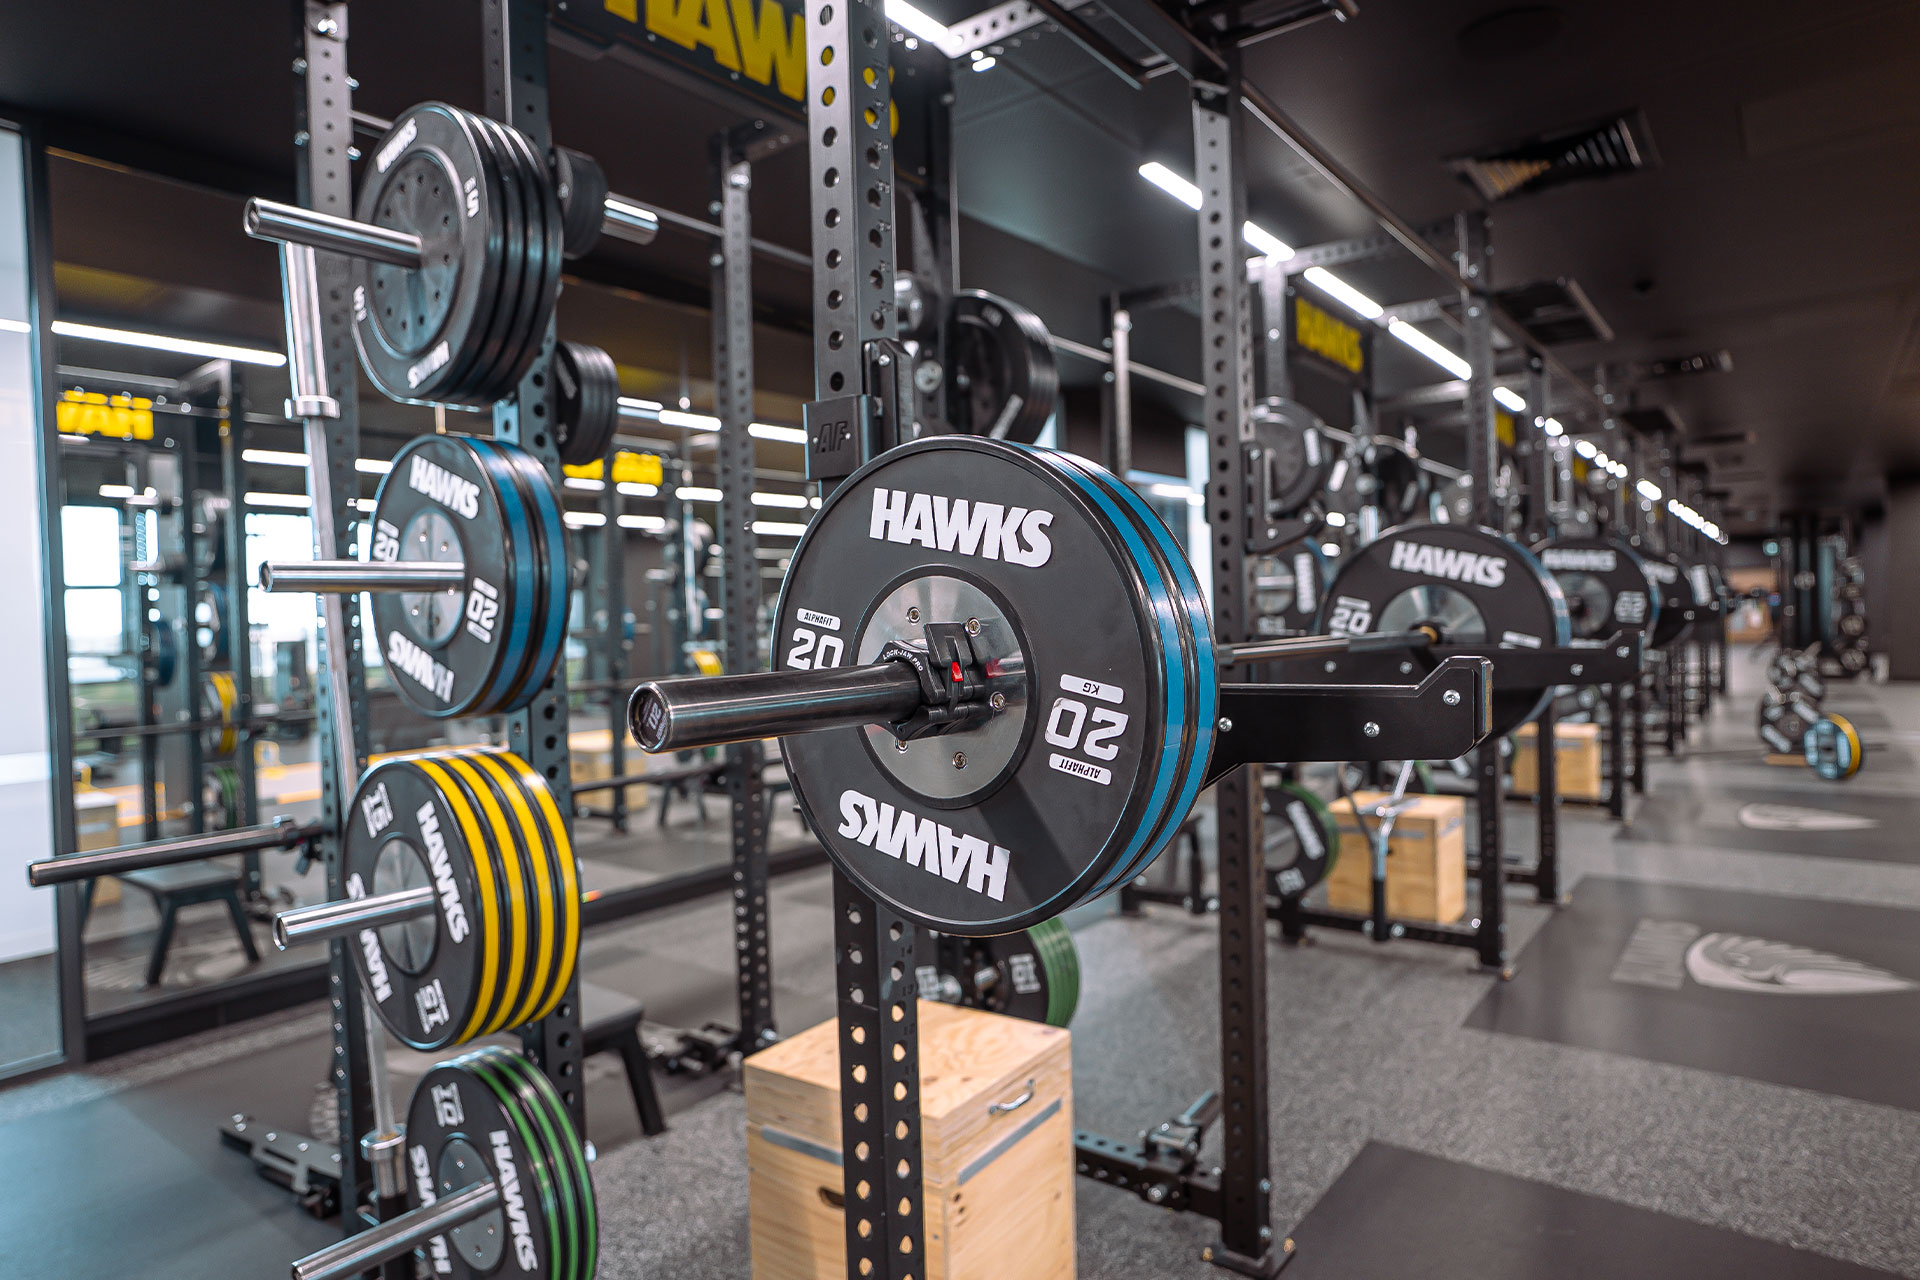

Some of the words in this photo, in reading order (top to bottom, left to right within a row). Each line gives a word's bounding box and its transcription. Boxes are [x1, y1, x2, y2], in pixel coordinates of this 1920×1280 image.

[409, 454, 481, 520] HAWKS
[373, 531, 400, 562] 20
[870, 487, 1054, 568] HAWKS
[1389, 540, 1507, 588] HAWKS
[466, 590, 499, 630] 20
[804, 612, 834, 627] ALPHAFIT
[1328, 606, 1373, 635] 20
[787, 627, 845, 670] 20
[882, 649, 913, 661] LOCK-JAW
[911, 657, 924, 671] PRO
[1082, 682, 1100, 695] KG
[1045, 697, 1129, 761] 20
[1059, 758, 1101, 779] ALPHAFIT
[838, 789, 1011, 902] HAWKS
[416, 800, 470, 944] HAWKS
[489, 1129, 538, 1272] HAWKS
